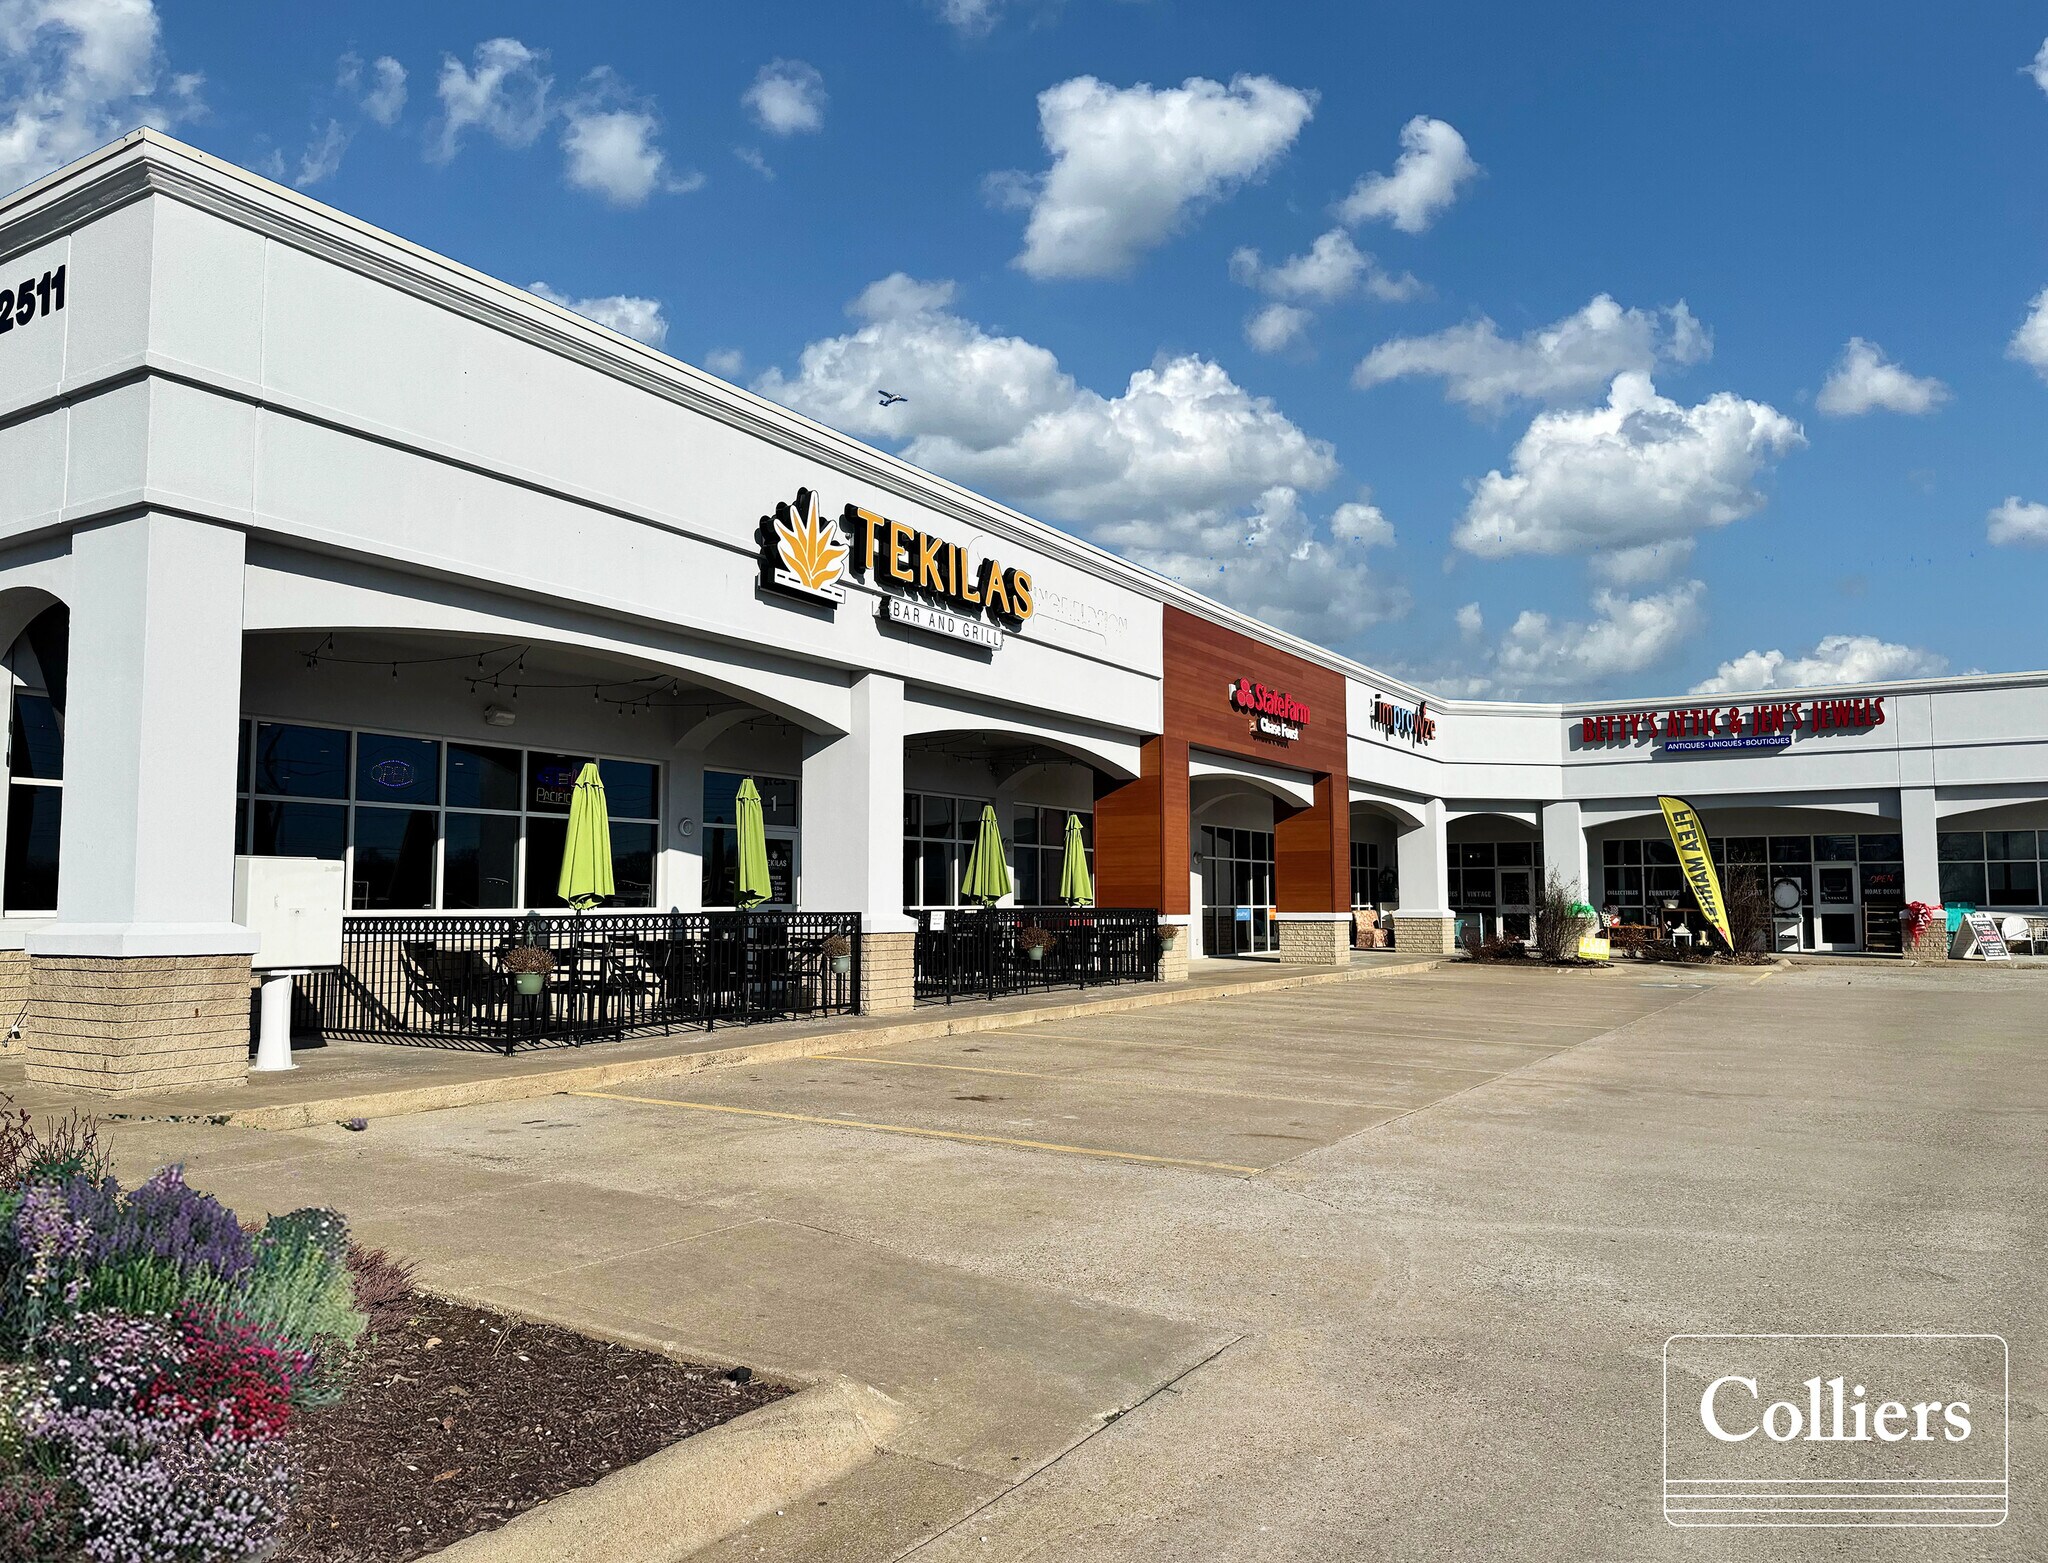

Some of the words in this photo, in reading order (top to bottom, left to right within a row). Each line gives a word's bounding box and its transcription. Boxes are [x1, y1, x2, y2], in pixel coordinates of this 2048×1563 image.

[0, 264, 66, 335] 2511
[857, 507, 1033, 620] TEKILAS
[893, 601, 920, 623] BAR
[929, 612, 955, 633] AND
[962, 622, 999, 646] GRILL
[1583, 712, 1658, 742] BETTY'S
[1667, 708, 1721, 738] ATTIC
[1728, 706, 1743, 734] &
[1752, 702, 1803, 736] JEN'S
[1811, 697, 1886, 733] JEWELS
[1466, 890, 1492, 898] VINTAGE
[1870, 874, 1895, 884] OPEN
